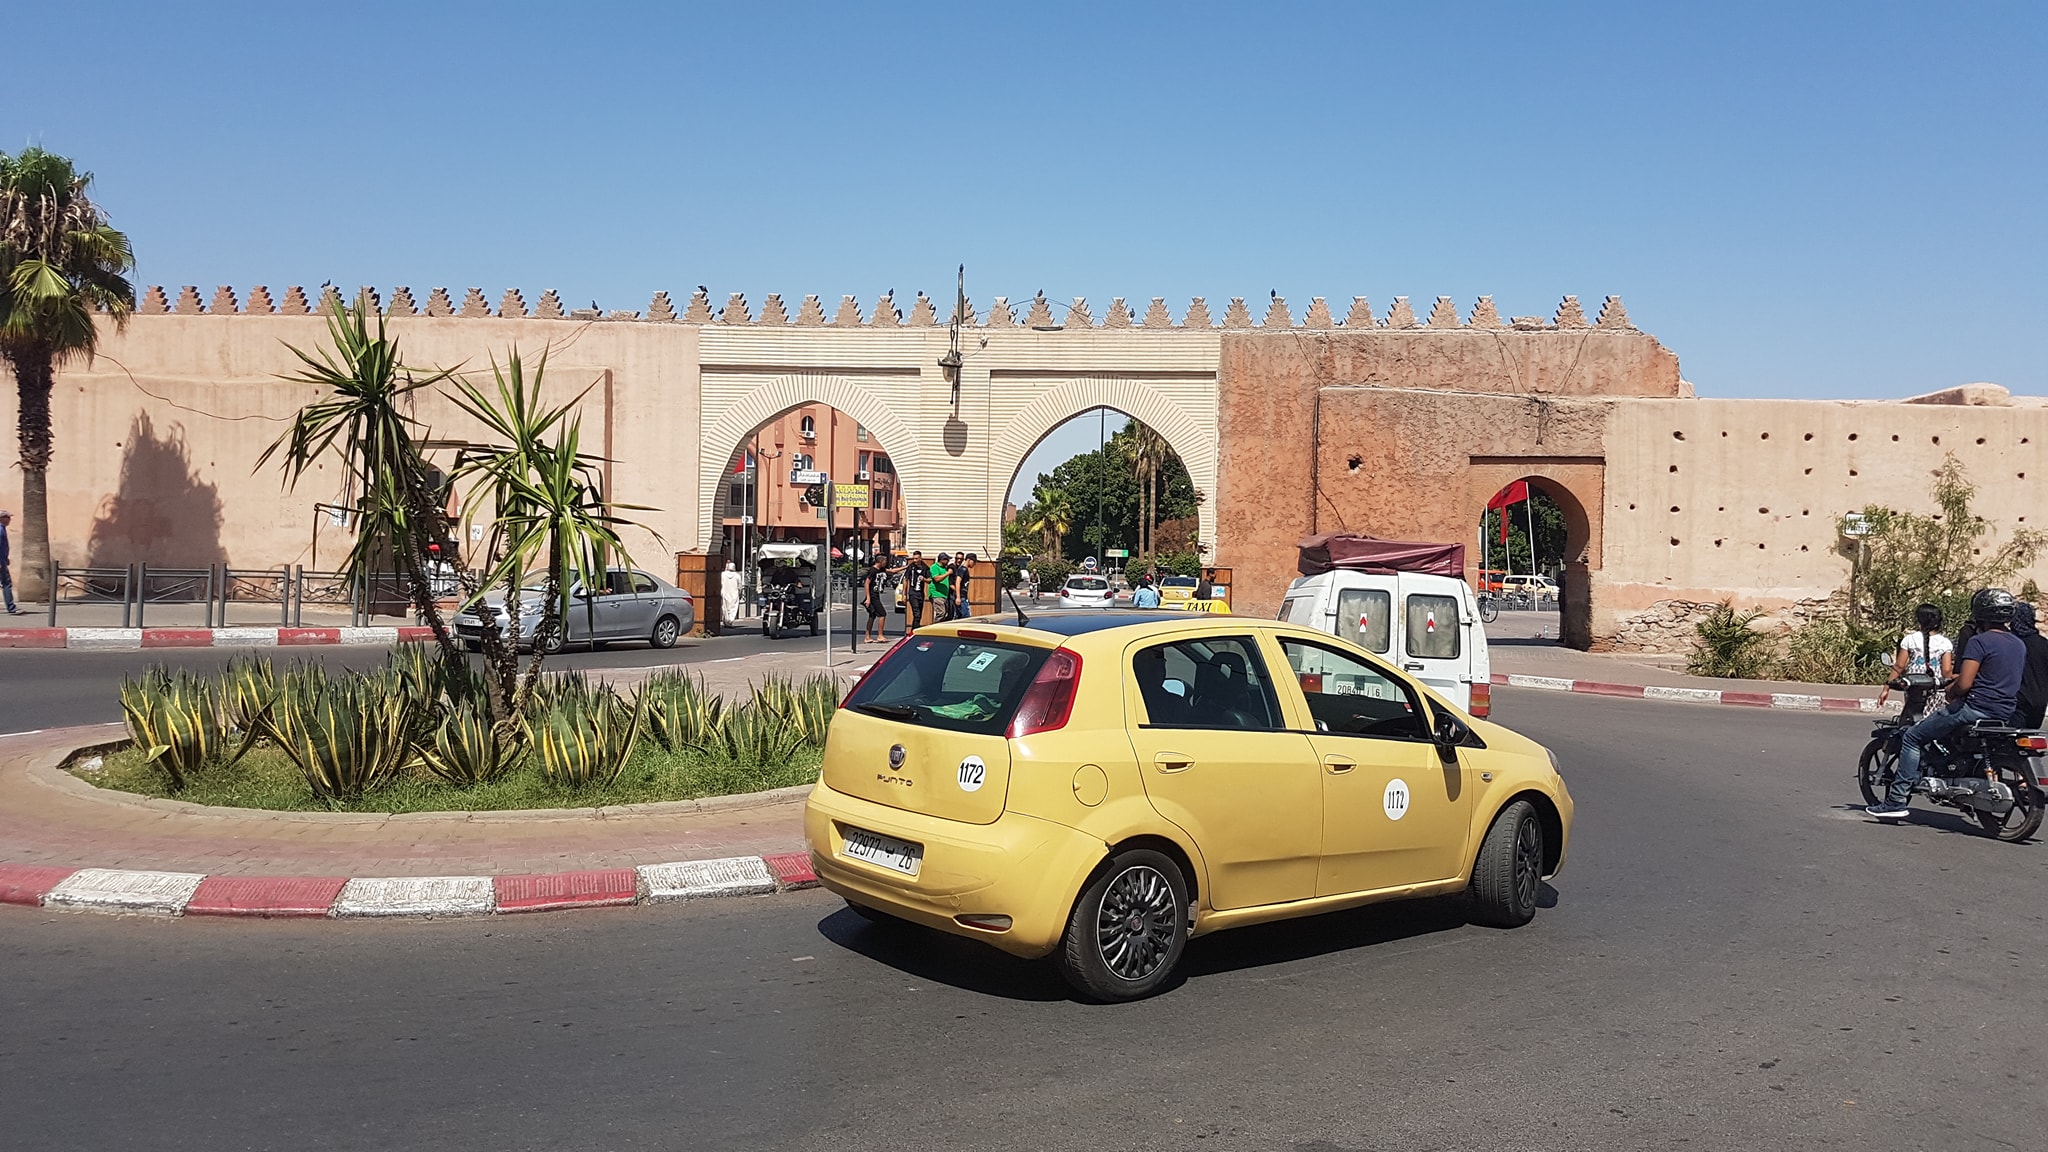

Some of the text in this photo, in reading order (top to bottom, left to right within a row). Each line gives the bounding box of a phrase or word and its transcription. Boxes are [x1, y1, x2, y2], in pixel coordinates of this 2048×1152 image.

[1187, 602, 1212, 612] TAXI
[877, 774, 914, 787] PUNTO
[959, 762, 984, 784] 1172
[1387, 790, 1405, 809] 1172
[848, 832, 881, 858] 22977
[898, 846, 915, 870] 26
